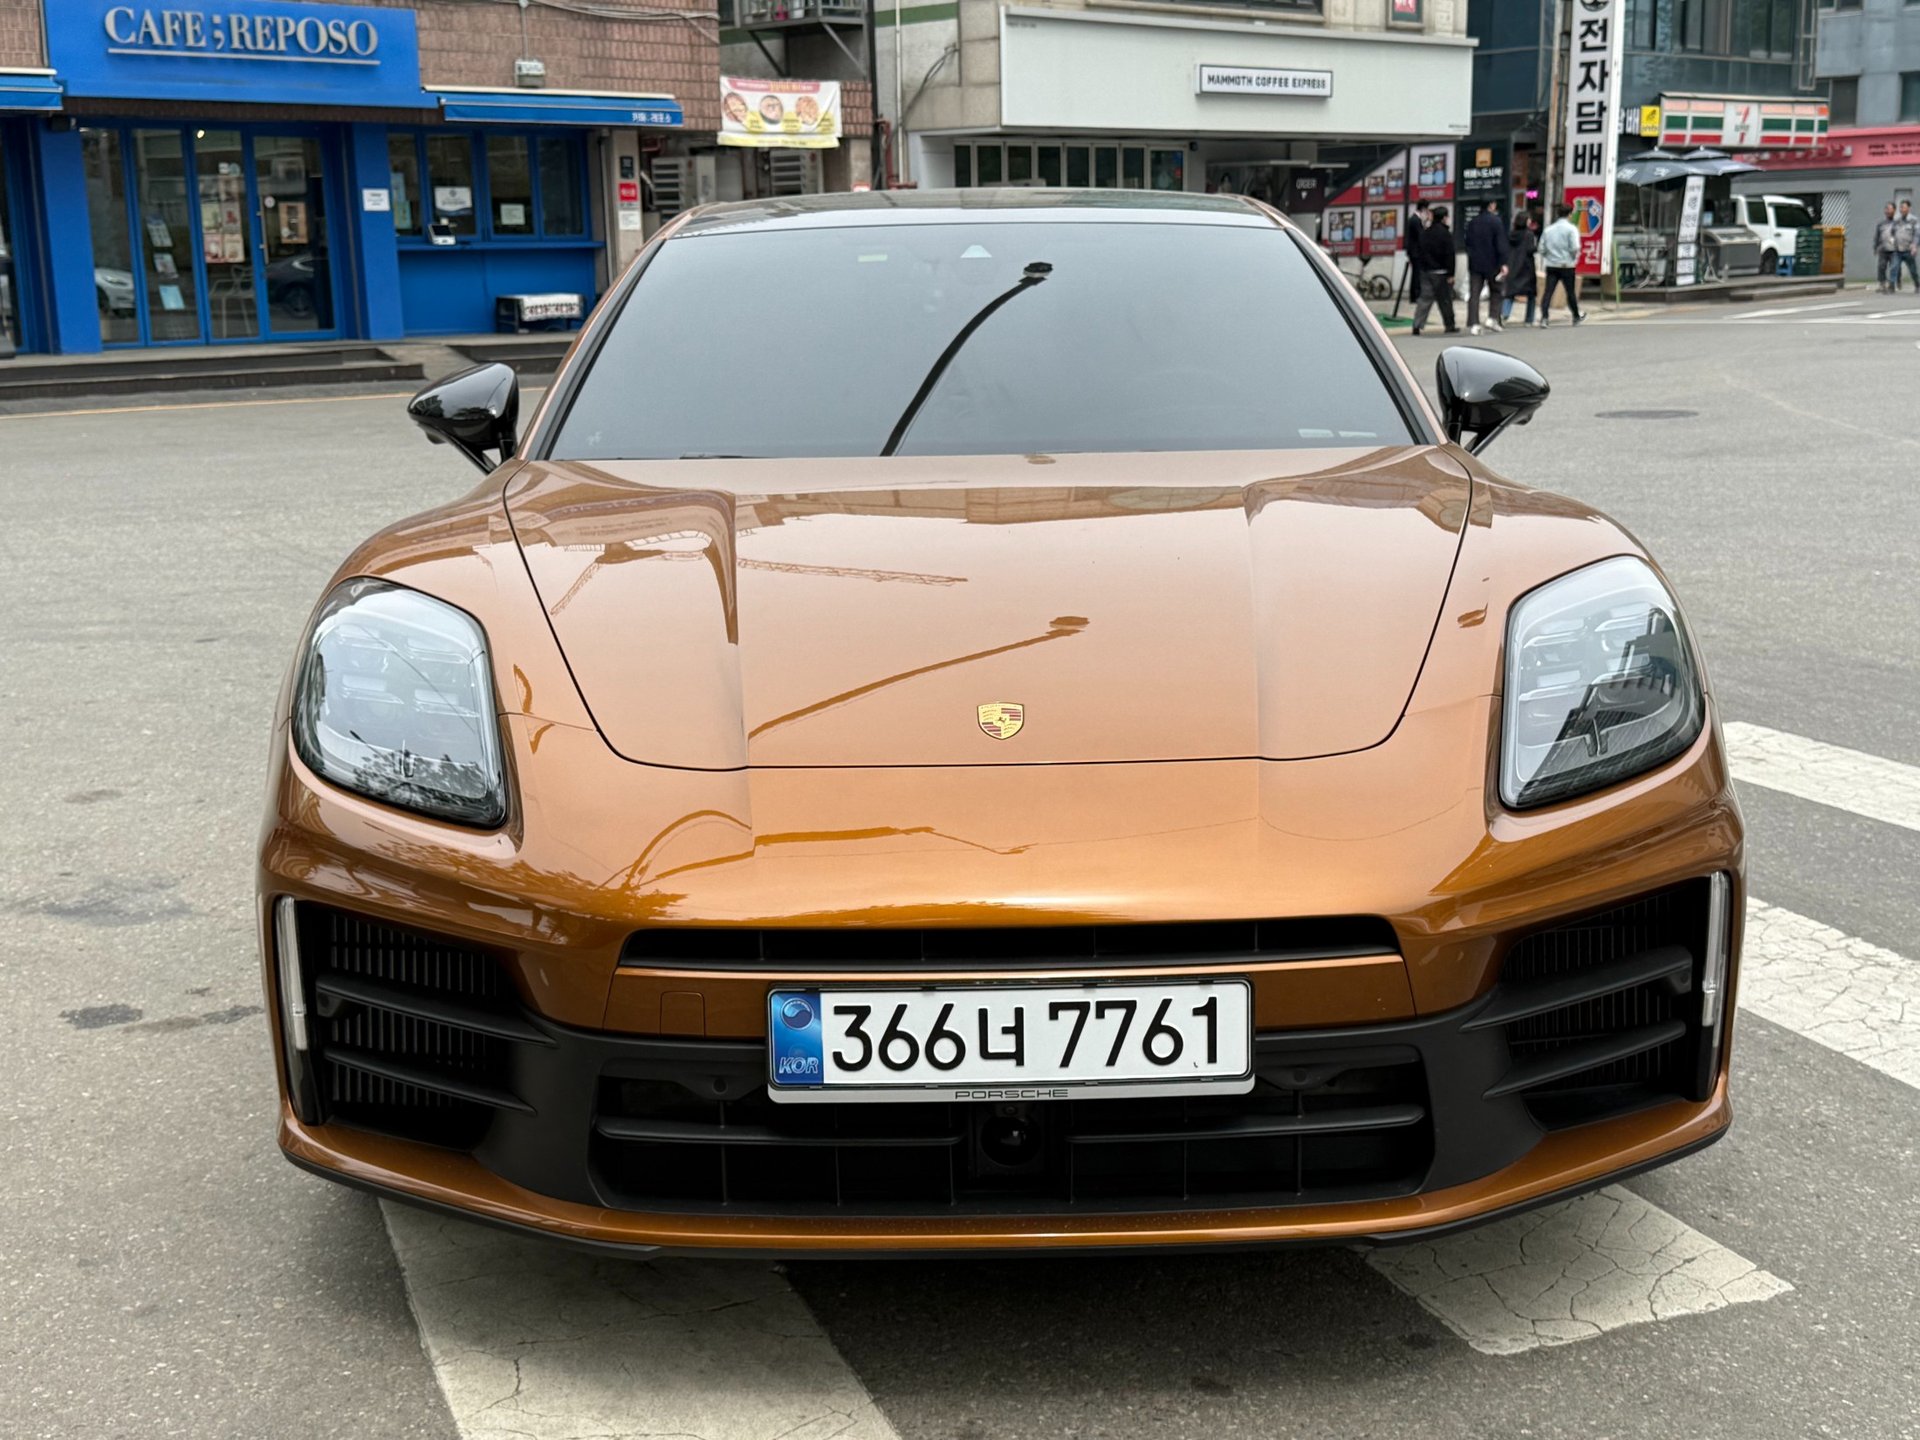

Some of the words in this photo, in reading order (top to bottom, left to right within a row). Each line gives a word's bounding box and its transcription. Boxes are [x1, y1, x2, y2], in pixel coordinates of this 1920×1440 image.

[1206, 74, 1253, 87] MAMMOTH
[1255, 76, 1289, 89] COFFEE
[1291, 77, 1326, 90] EXPRESS
[1573, 17, 1609, 176] 전자담배
[1582, 240, 1601, 265] 권
[832, 1002, 1025, 1072] 366너
[1048, 996, 1219, 1068] 7761
[778, 1056, 819, 1074] KOR
[955, 1088, 1069, 1100] PORSCHE
